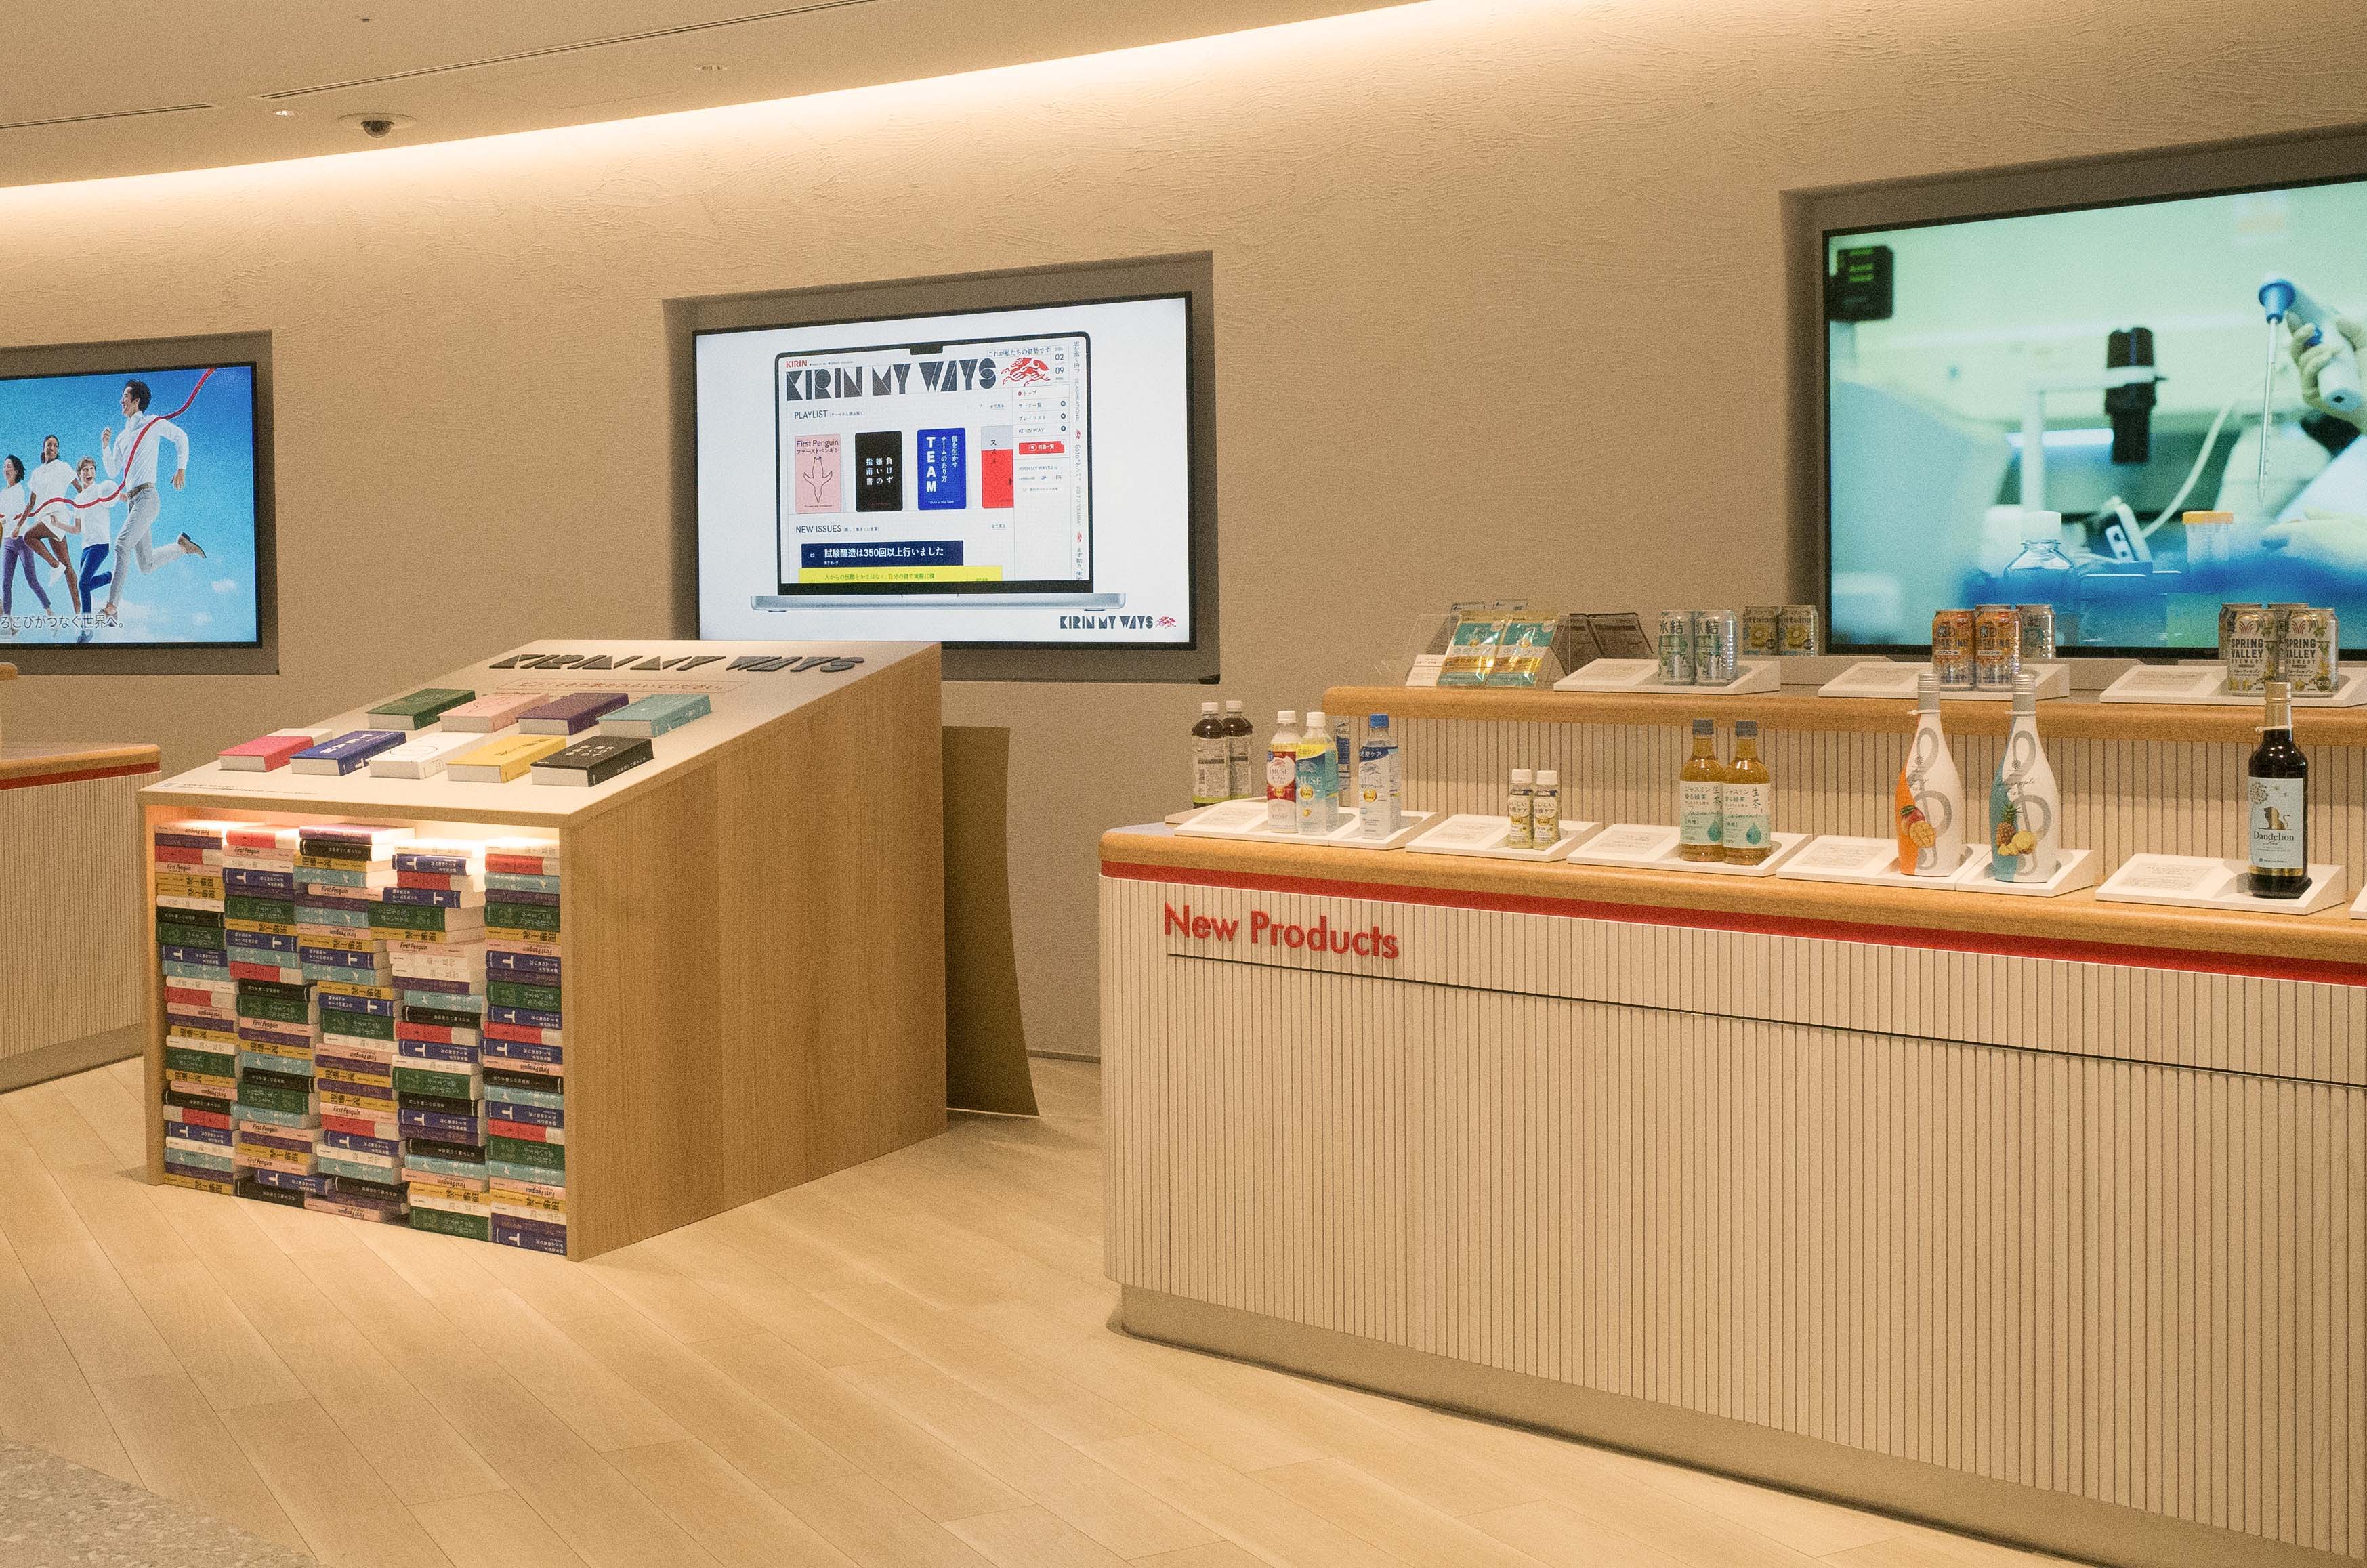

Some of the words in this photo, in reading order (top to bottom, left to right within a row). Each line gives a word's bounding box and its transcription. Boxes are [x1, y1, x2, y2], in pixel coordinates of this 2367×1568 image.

[988, 347, 1050, 357] これが私たちの姿勢です
[787, 366, 862, 401] KIRIN
[872, 364, 911, 395] MY
[919, 358, 996, 392] WAYS
[795, 410, 828, 419] PLAYLIST
[813, 439, 839, 448] Penguin
[926, 436, 936, 492] TEAM
[824, 547, 944, 559] 試験醸造は350回以上行いました
[1, 614, 123, 629] ろこびがつなぐ世界へ。
[1060, 616, 1095, 629] KIRIN
[1099, 616, 1116, 629] MY
[1120, 616, 1153, 629] WAYS
[1660, 620, 1683, 634] 氷結
[1696, 620, 1718, 634] 氷結
[2231, 639, 2263, 648] SPRING
[2286, 639, 2316, 648] SPRING
[2231, 649, 2263, 658] VALLEY
[1752, 787, 1761, 807] 生茶
[2254, 831, 2294, 840] Dandelion
[1165, 902, 1239, 942] New
[1251, 910, 1399, 959] Products
